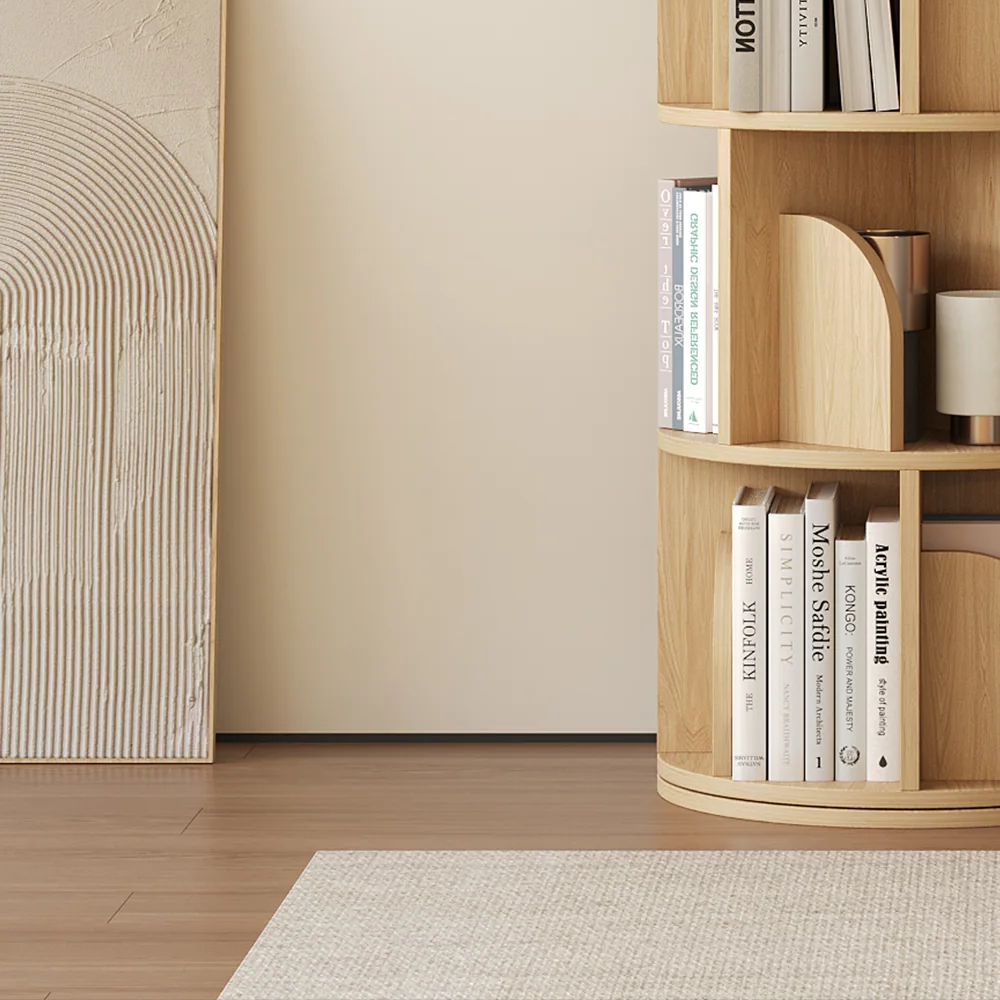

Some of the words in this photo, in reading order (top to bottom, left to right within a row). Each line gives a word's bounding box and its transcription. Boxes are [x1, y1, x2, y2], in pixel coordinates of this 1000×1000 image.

[745, 558, 754, 585] HOME
[812, 523, 831, 593] Moshe
[874, 543, 889, 595] Acrylic
[780, 533, 793, 665] SIMPLICITY
[742, 601, 757, 681] KINFOLK
[812, 600, 831, 662] Safdie
[874, 600, 889, 665] painting
[745, 693, 753, 712] THE
[816, 674, 824, 704] Modern
[878, 697, 887, 705] of
[816, 706, 824, 745] Architects
[877, 707, 886, 736] painting
